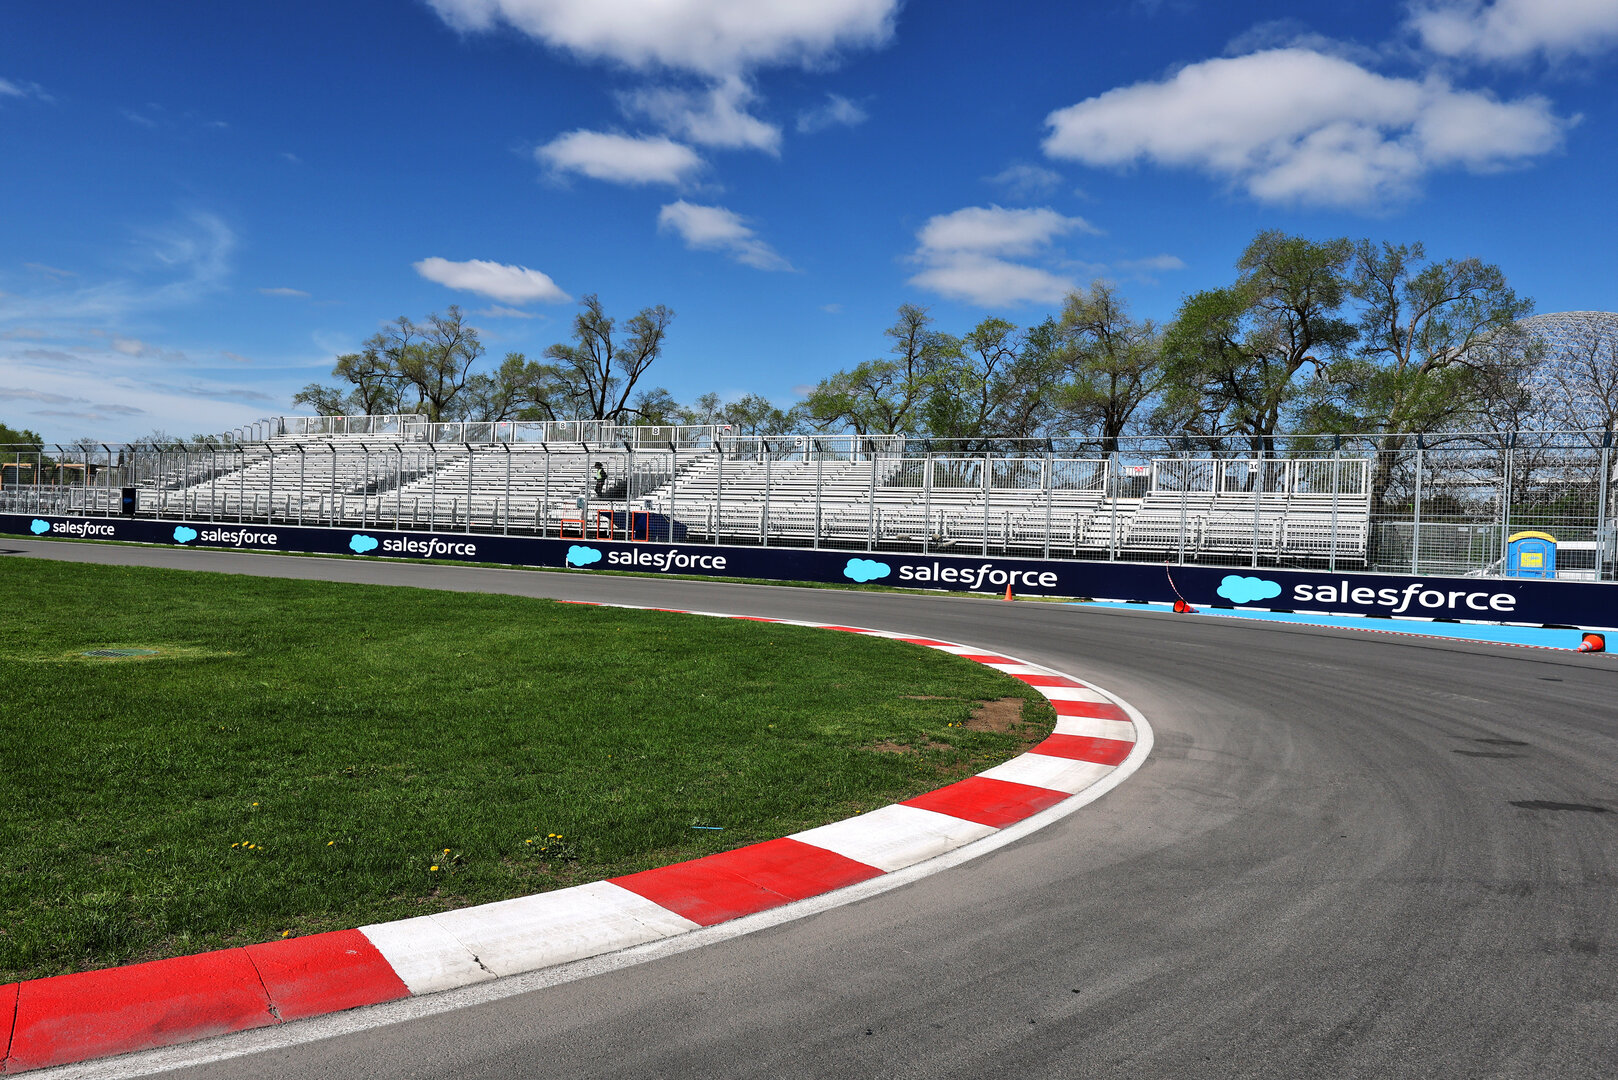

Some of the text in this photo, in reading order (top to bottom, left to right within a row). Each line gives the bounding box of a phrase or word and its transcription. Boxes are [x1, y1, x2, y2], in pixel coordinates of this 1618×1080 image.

[52, 520, 115, 538] salesforce
[200, 528, 278, 547] salesforce
[382, 537, 477, 558] salesforce
[607, 548, 727, 572] salesforce
[898, 562, 1059, 590] salesforce
[1293, 581, 1518, 614] salesforce
